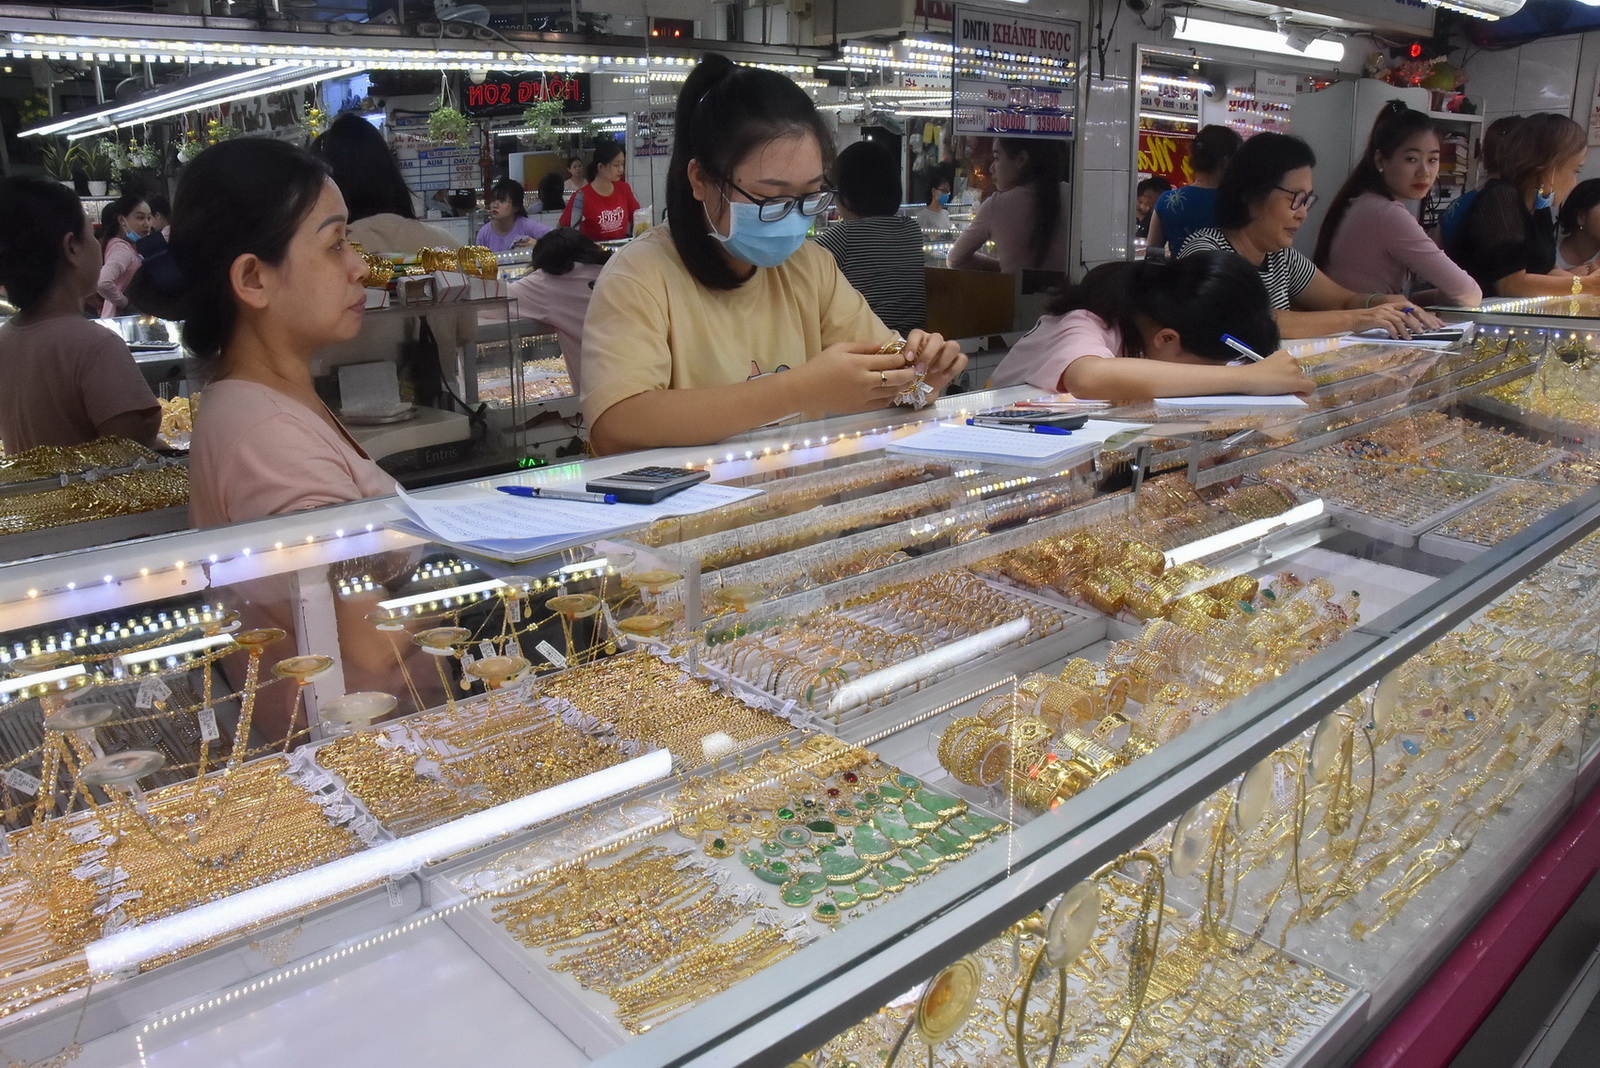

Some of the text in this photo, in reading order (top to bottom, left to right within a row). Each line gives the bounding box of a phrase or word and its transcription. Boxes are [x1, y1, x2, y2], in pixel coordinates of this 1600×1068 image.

[963, 19, 1071, 54] DNTN KHÁNH NGỌC
[987, 89, 1006, 101] Ngày
[989, 113, 1026, 129] 3190000
[1036, 115, 1071, 131] 3390000
[425, 447, 458, 463] Entris
